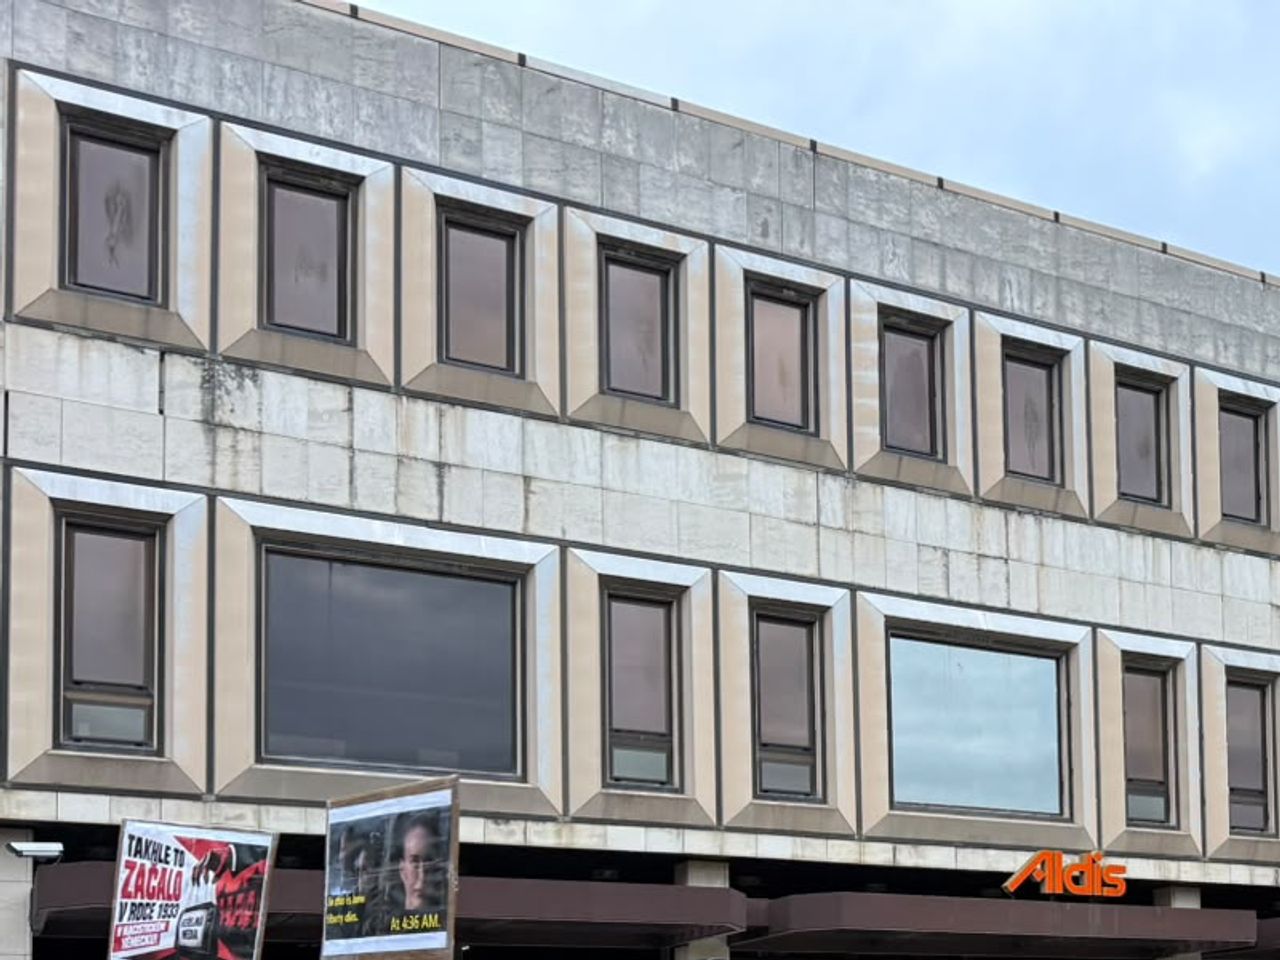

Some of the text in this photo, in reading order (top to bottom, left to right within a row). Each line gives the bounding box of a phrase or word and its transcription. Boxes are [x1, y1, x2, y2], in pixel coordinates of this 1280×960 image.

[127, 834, 185, 868] TAKHLE TO
[121, 858, 183, 902] ZAČALO
[1001, 850, 1127, 897] Aldis
[119, 902, 180, 922] V ROCE 1933
